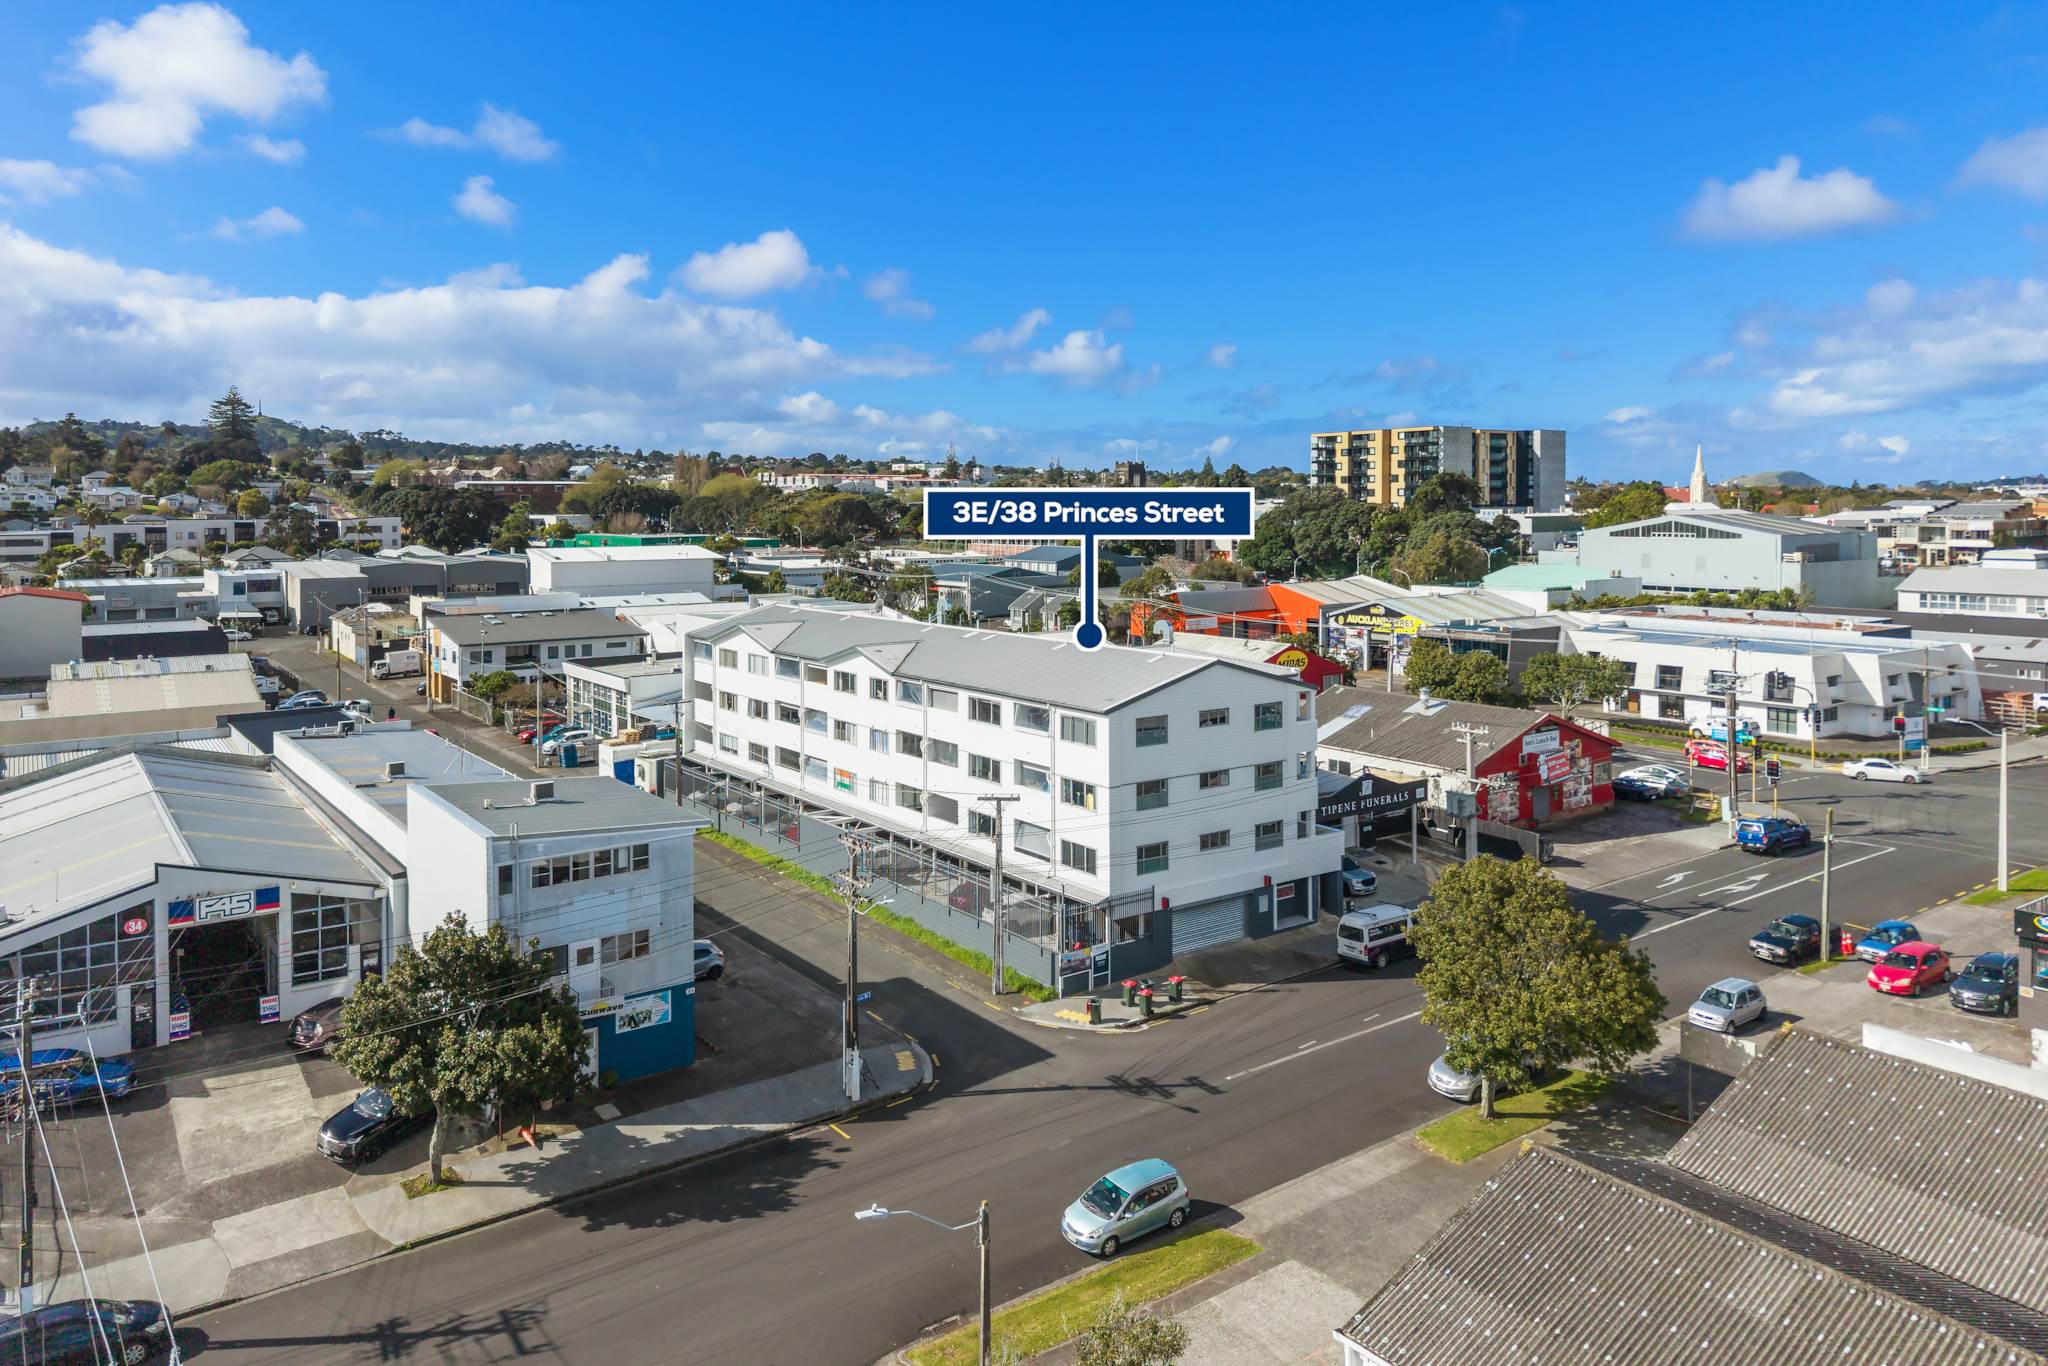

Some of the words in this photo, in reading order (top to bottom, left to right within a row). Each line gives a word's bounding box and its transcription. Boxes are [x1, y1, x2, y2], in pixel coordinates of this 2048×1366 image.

[1321, 801, 1357, 816] TIPENE
[1360, 791, 1409, 809] FUNERALS
[128, 920, 143, 932] 34
